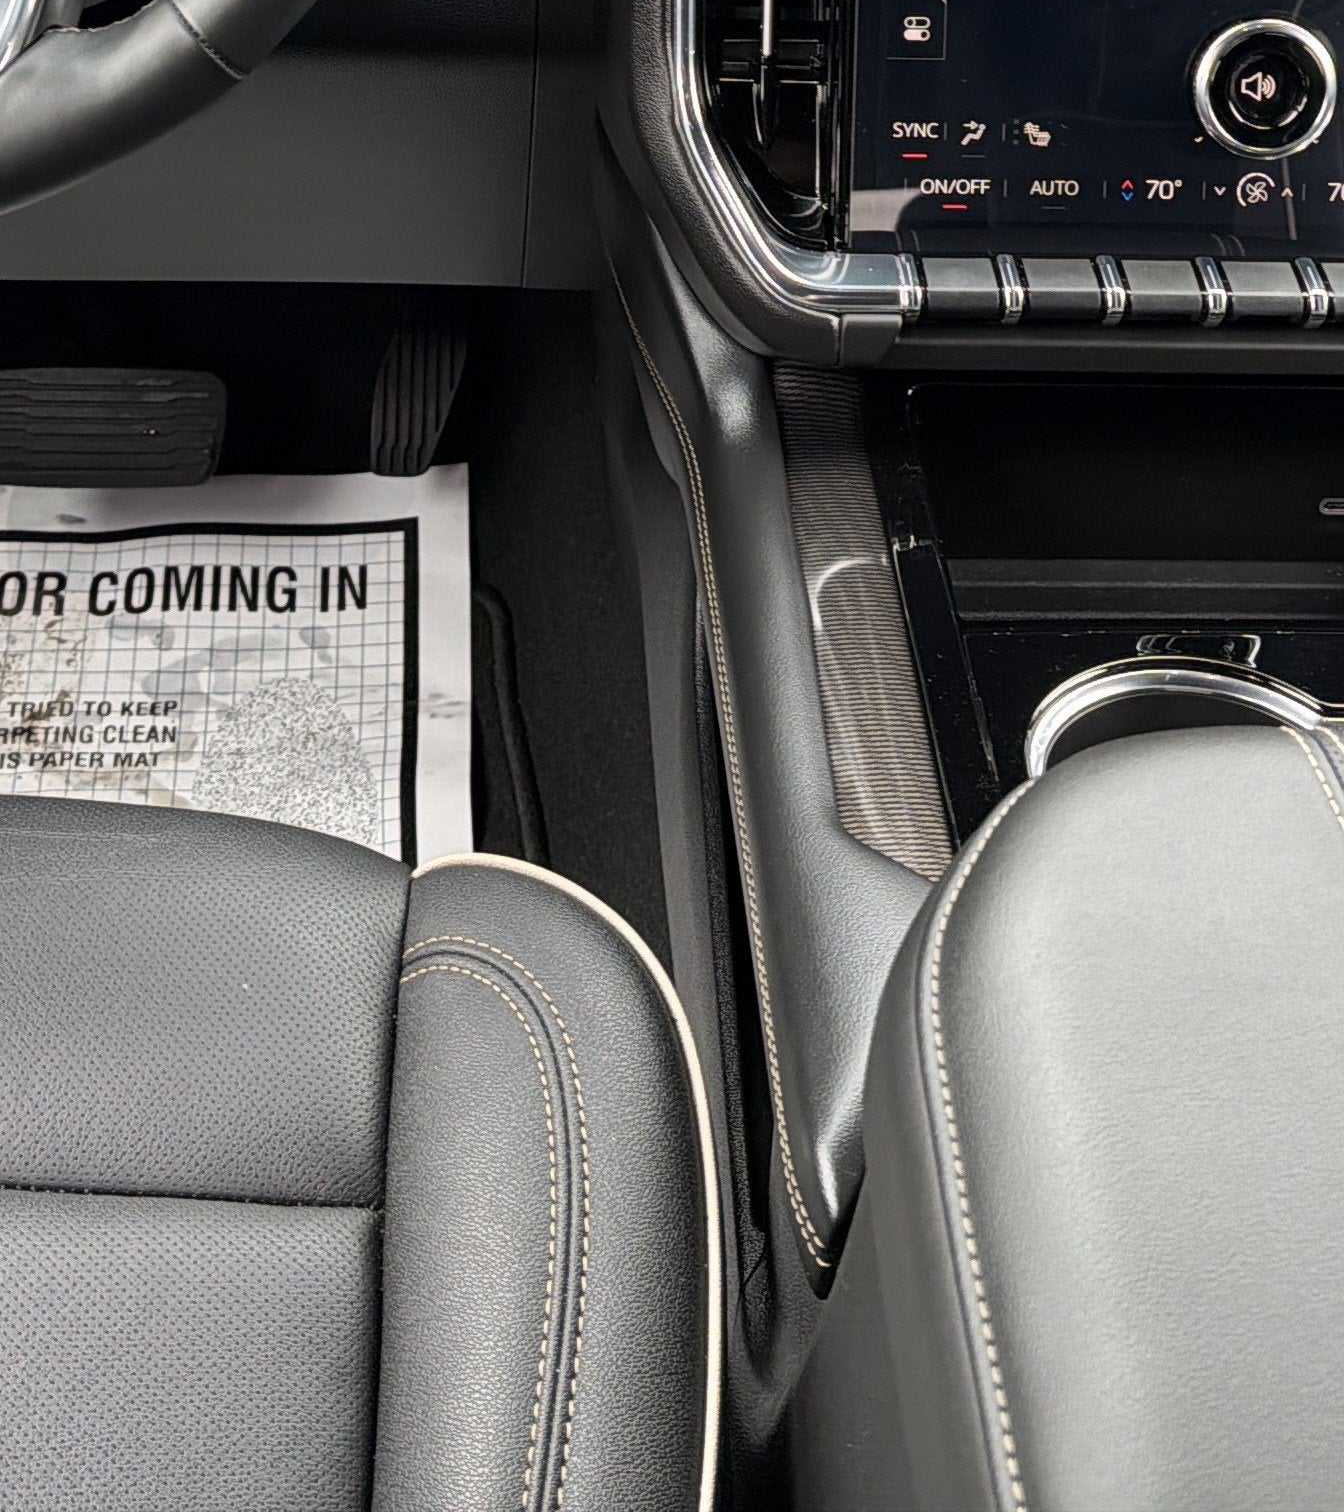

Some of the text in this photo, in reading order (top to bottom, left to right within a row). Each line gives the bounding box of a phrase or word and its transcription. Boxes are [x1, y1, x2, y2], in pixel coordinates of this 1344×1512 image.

[892, 122, 940, 139] SYNC
[920, 179, 991, 195] ON/OFF
[1030, 180, 1079, 196] AUTO
[1145, 179, 1182, 200] 70°
[88, 564, 297, 616] COMING
[319, 564, 369, 611] IN
[82, 700, 112, 719] TO
[120, 700, 179, 719] KEEP
[102, 724, 178, 745] CLEAN
[28, 750, 106, 770] PAPER
[111, 749, 163, 769] MAT
